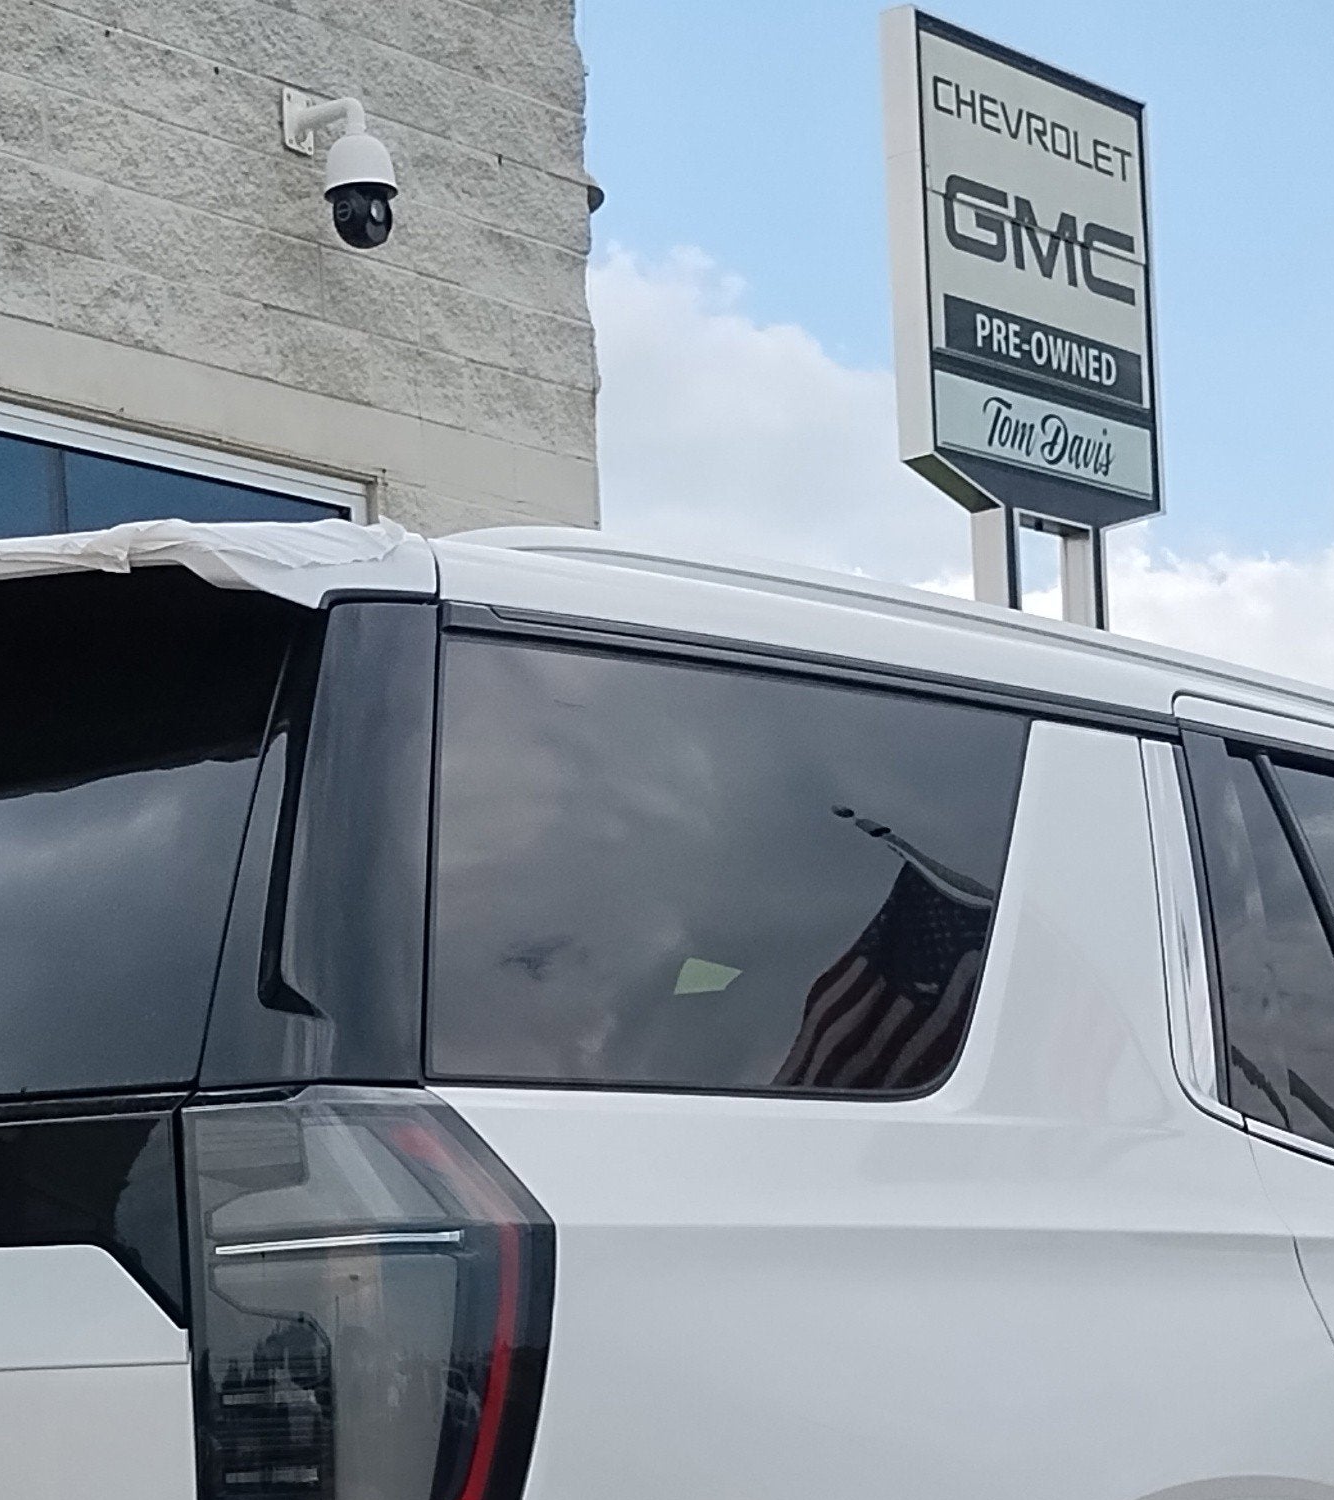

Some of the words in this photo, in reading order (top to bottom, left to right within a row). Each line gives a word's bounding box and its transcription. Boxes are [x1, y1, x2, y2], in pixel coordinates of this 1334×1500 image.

[932, 75, 1133, 182] CHEVROLET
[943, 173, 1136, 306] GMC
[975, 312, 1117, 387] PRE-OWNED
[983, 396, 1037, 458] Tom
[1040, 413, 1116, 477] Davis
